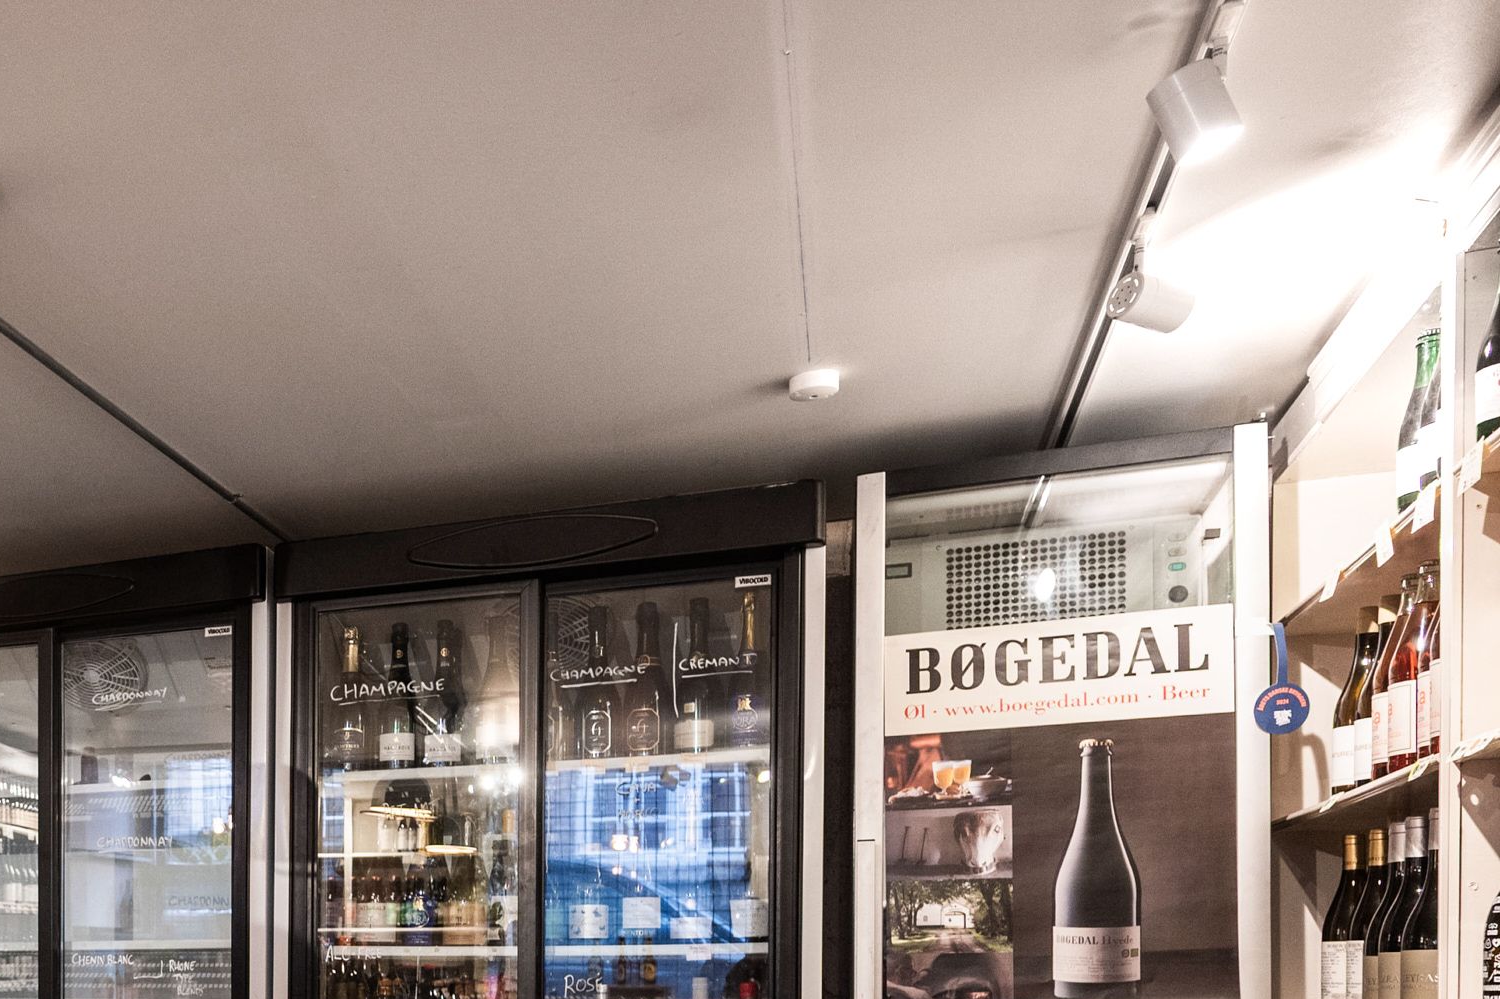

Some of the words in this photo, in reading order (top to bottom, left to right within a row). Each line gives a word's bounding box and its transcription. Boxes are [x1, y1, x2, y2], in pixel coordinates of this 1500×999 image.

[905, 623, 1210, 695] BØGEDAL
[550, 664, 647, 683] CHAMPAGNE
[91, 687, 168, 706] CHARDONNAY
[330, 678, 445, 702] CHAMPAGNE
[944, 692, 1139, 717] www.boegedal.com
[1162, 684, 1210, 701] Beer
[71, 953, 106, 967] CHENIN
[106, 953, 135, 966] BLANC
